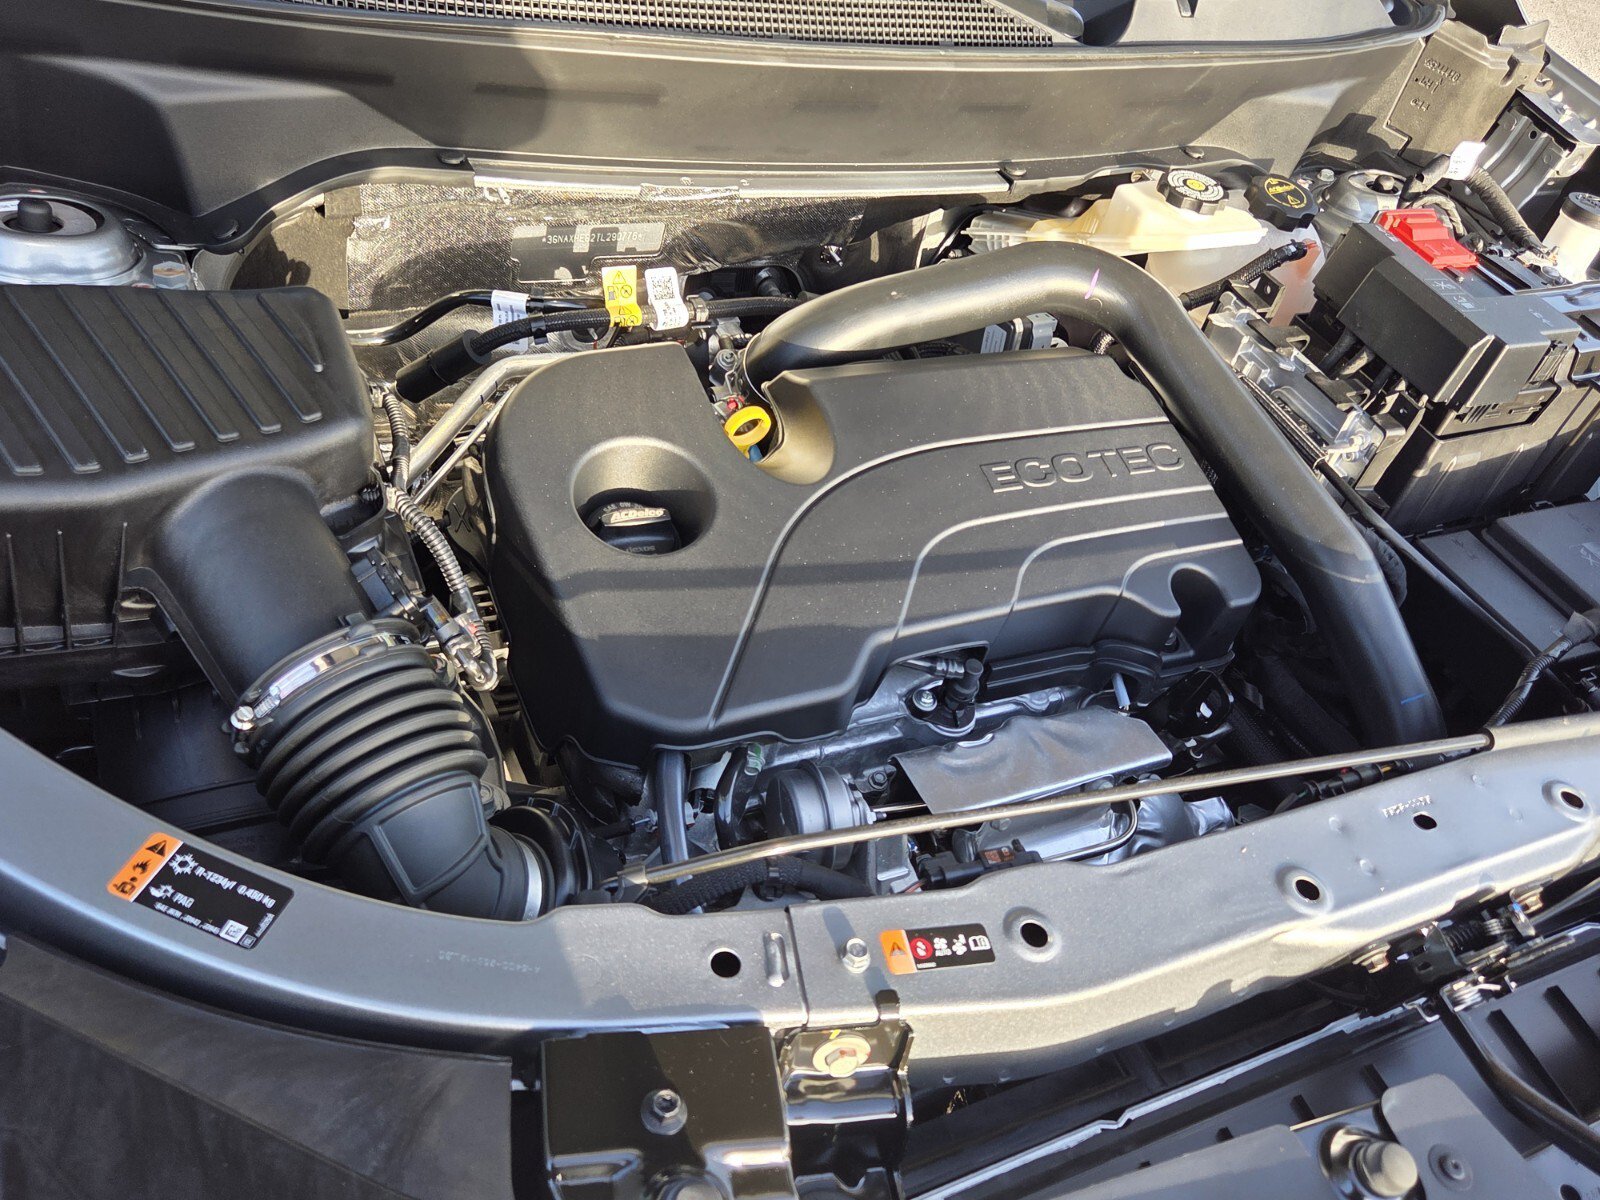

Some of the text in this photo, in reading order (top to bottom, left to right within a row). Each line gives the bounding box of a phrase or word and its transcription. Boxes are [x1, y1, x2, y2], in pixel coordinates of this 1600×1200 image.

[980, 442, 1184, 493] ECOTEC
[610, 509, 665, 523] ACDelco
[172, 892, 195, 909] PAG
